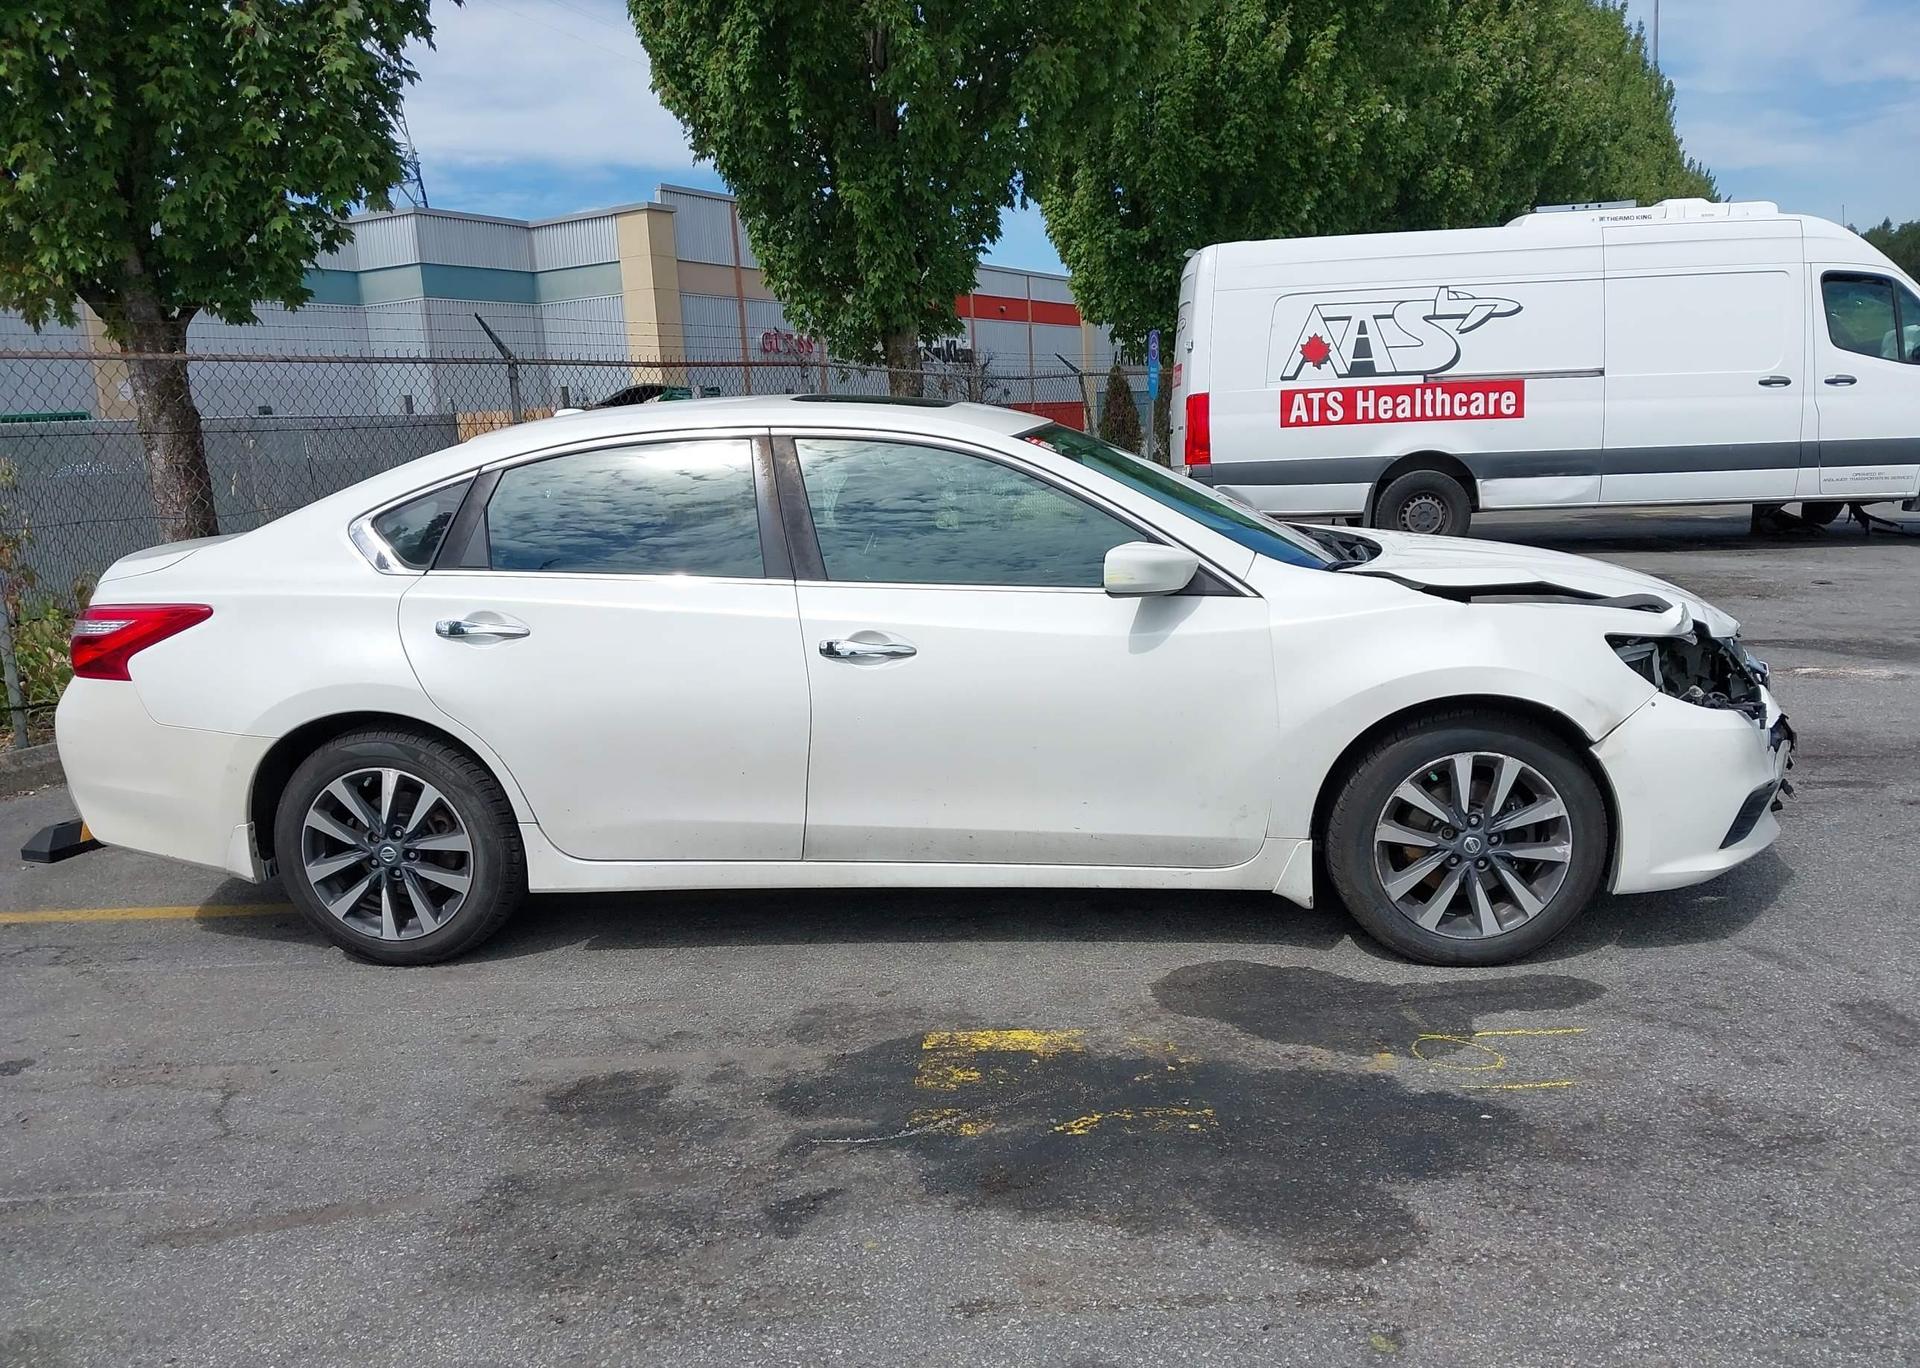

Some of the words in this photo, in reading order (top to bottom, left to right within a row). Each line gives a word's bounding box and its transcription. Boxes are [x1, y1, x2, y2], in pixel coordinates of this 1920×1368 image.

[1280, 298, 1462, 381] ATS
[1289, 391, 1344, 423] ATS
[1356, 386, 1517, 420] Healthcare
